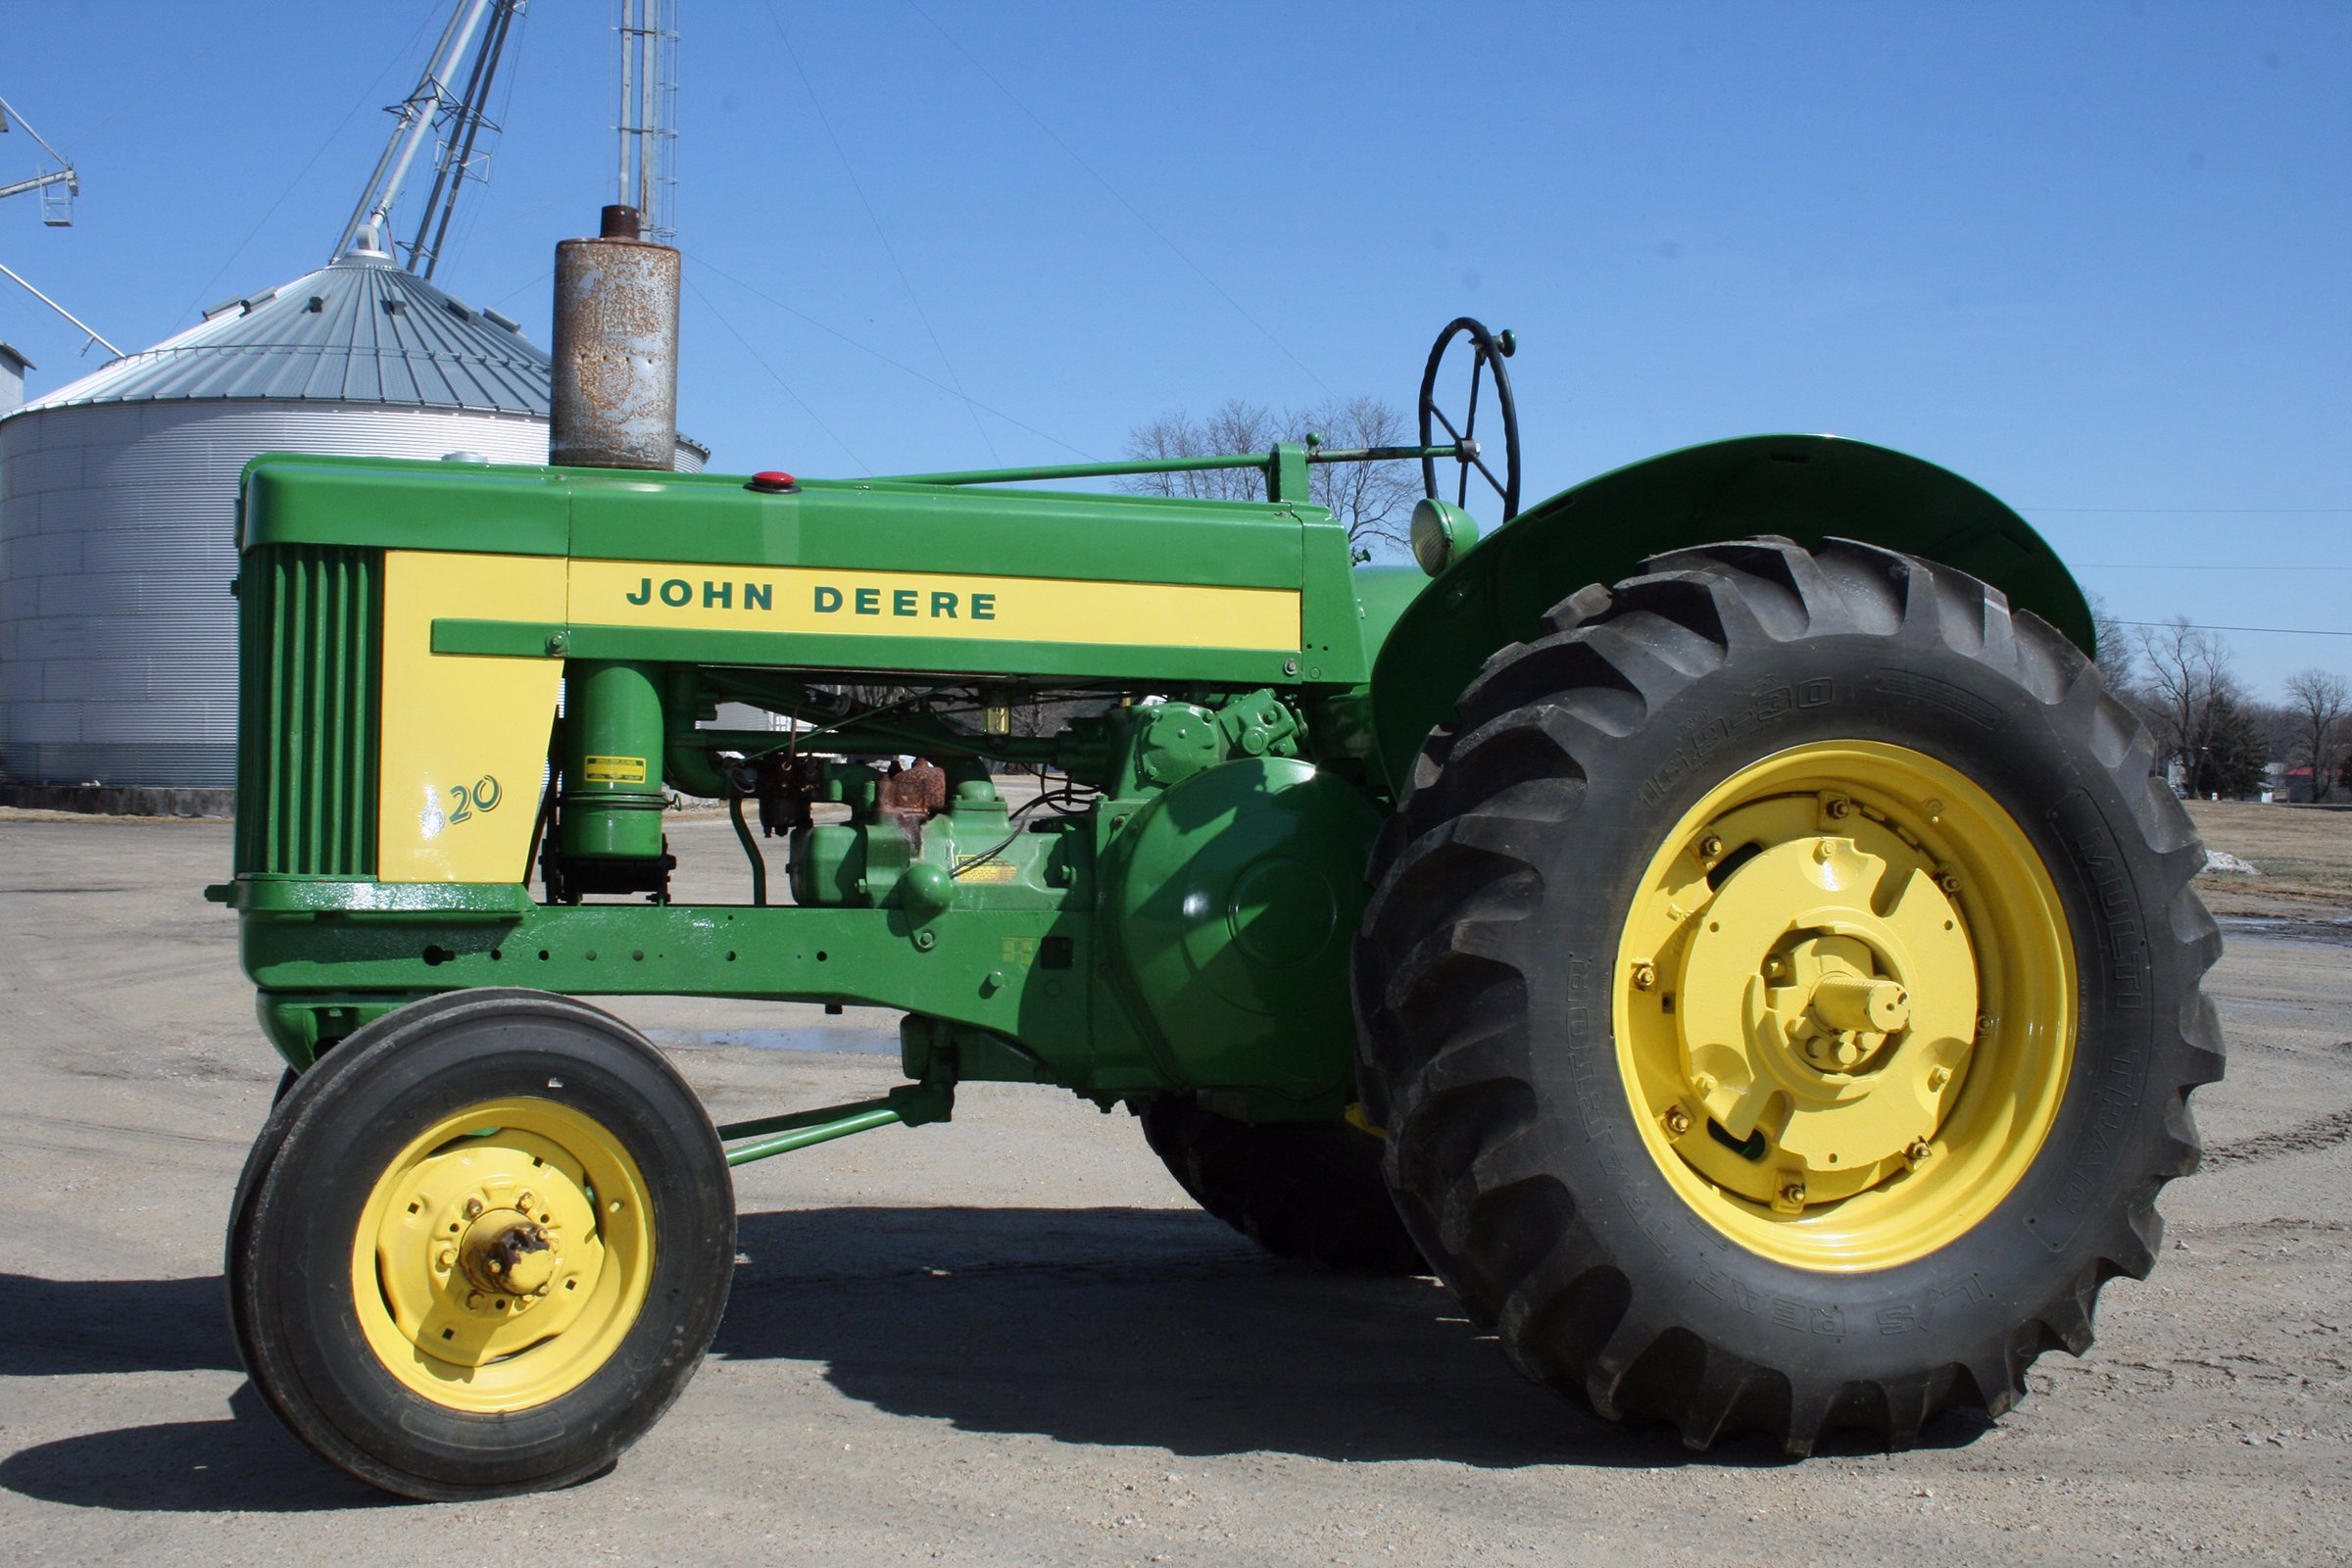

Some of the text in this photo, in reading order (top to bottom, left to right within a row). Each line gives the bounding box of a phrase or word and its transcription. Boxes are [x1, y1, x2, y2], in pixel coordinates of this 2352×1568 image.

[625, 577, 997, 620] JOHN DEERE
[2077, 826, 2144, 1010] MULTI
